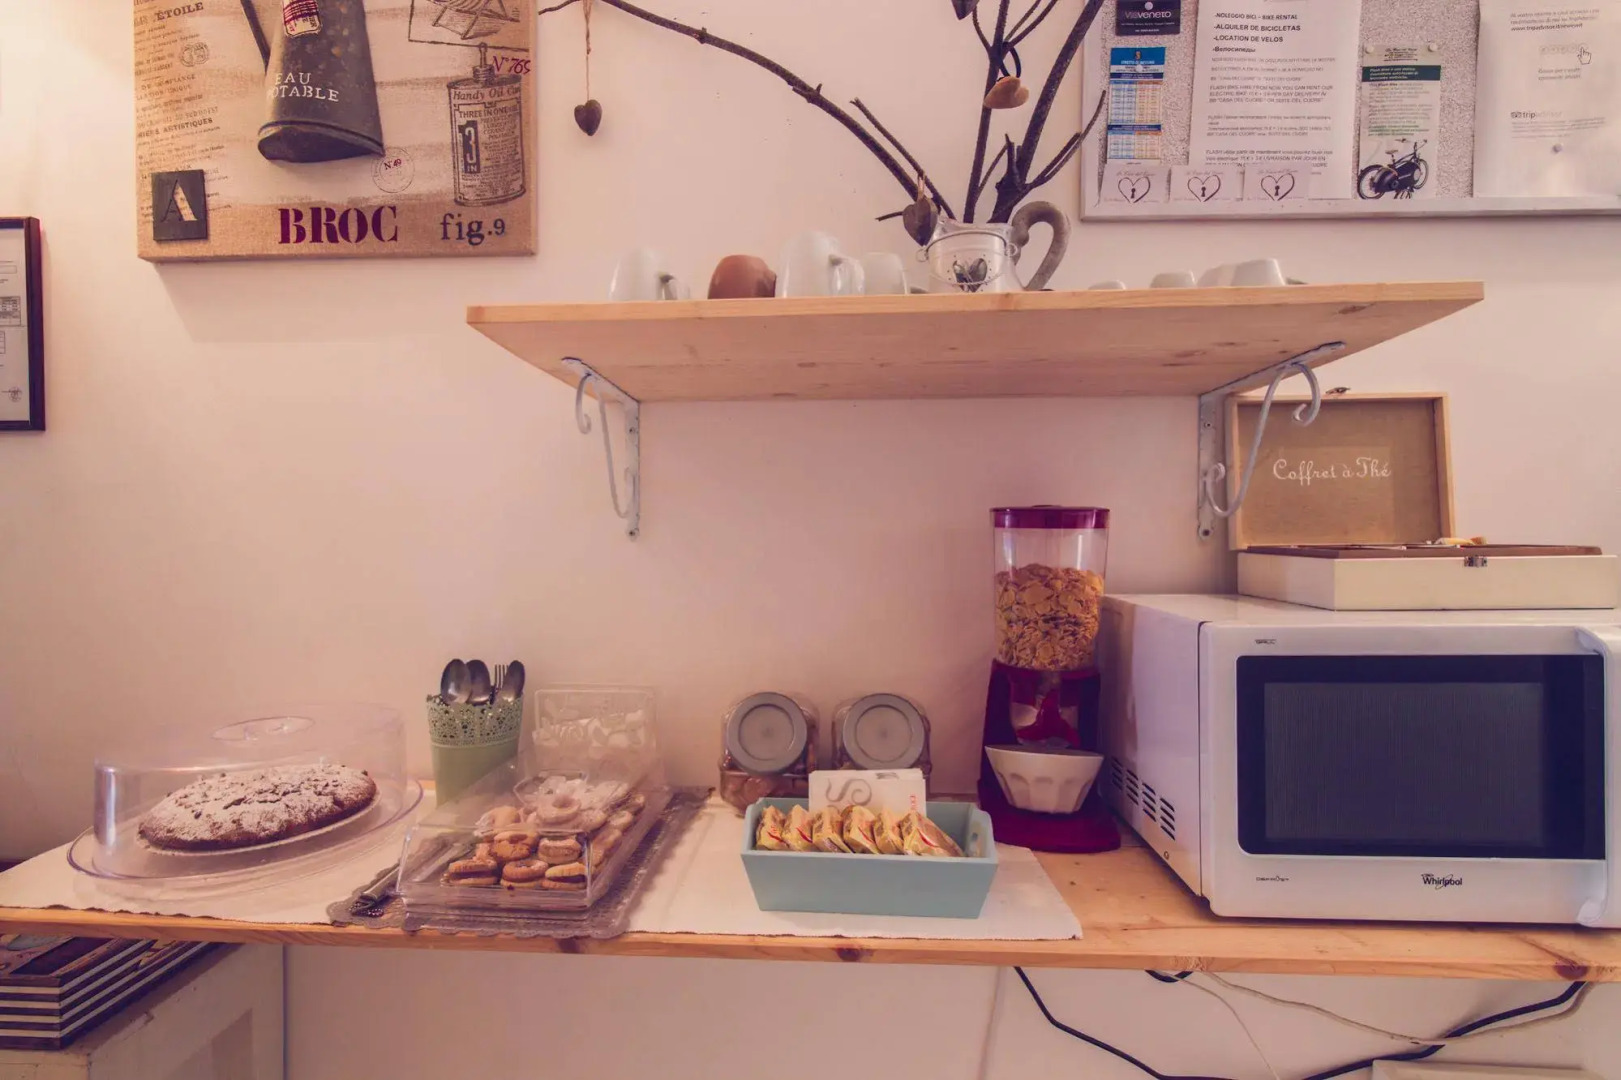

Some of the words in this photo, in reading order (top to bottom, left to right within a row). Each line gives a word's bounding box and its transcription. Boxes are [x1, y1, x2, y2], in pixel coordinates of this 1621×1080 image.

[1260, 24, 1301, 32] BICICLETAS
[275, 72, 311, 85] EAU
[453, 89, 484, 100] Handy
[459, 110, 482, 119] THREE
[278, 205, 398, 244] BROC
[440, 213, 506, 246] fig.9
[1273, 458, 1338, 486] Coffret
[1342, 463, 1354, 478] à
[1356, 457, 1392, 478] Thé
[1421, 874, 1463, 888] Whirlpool
